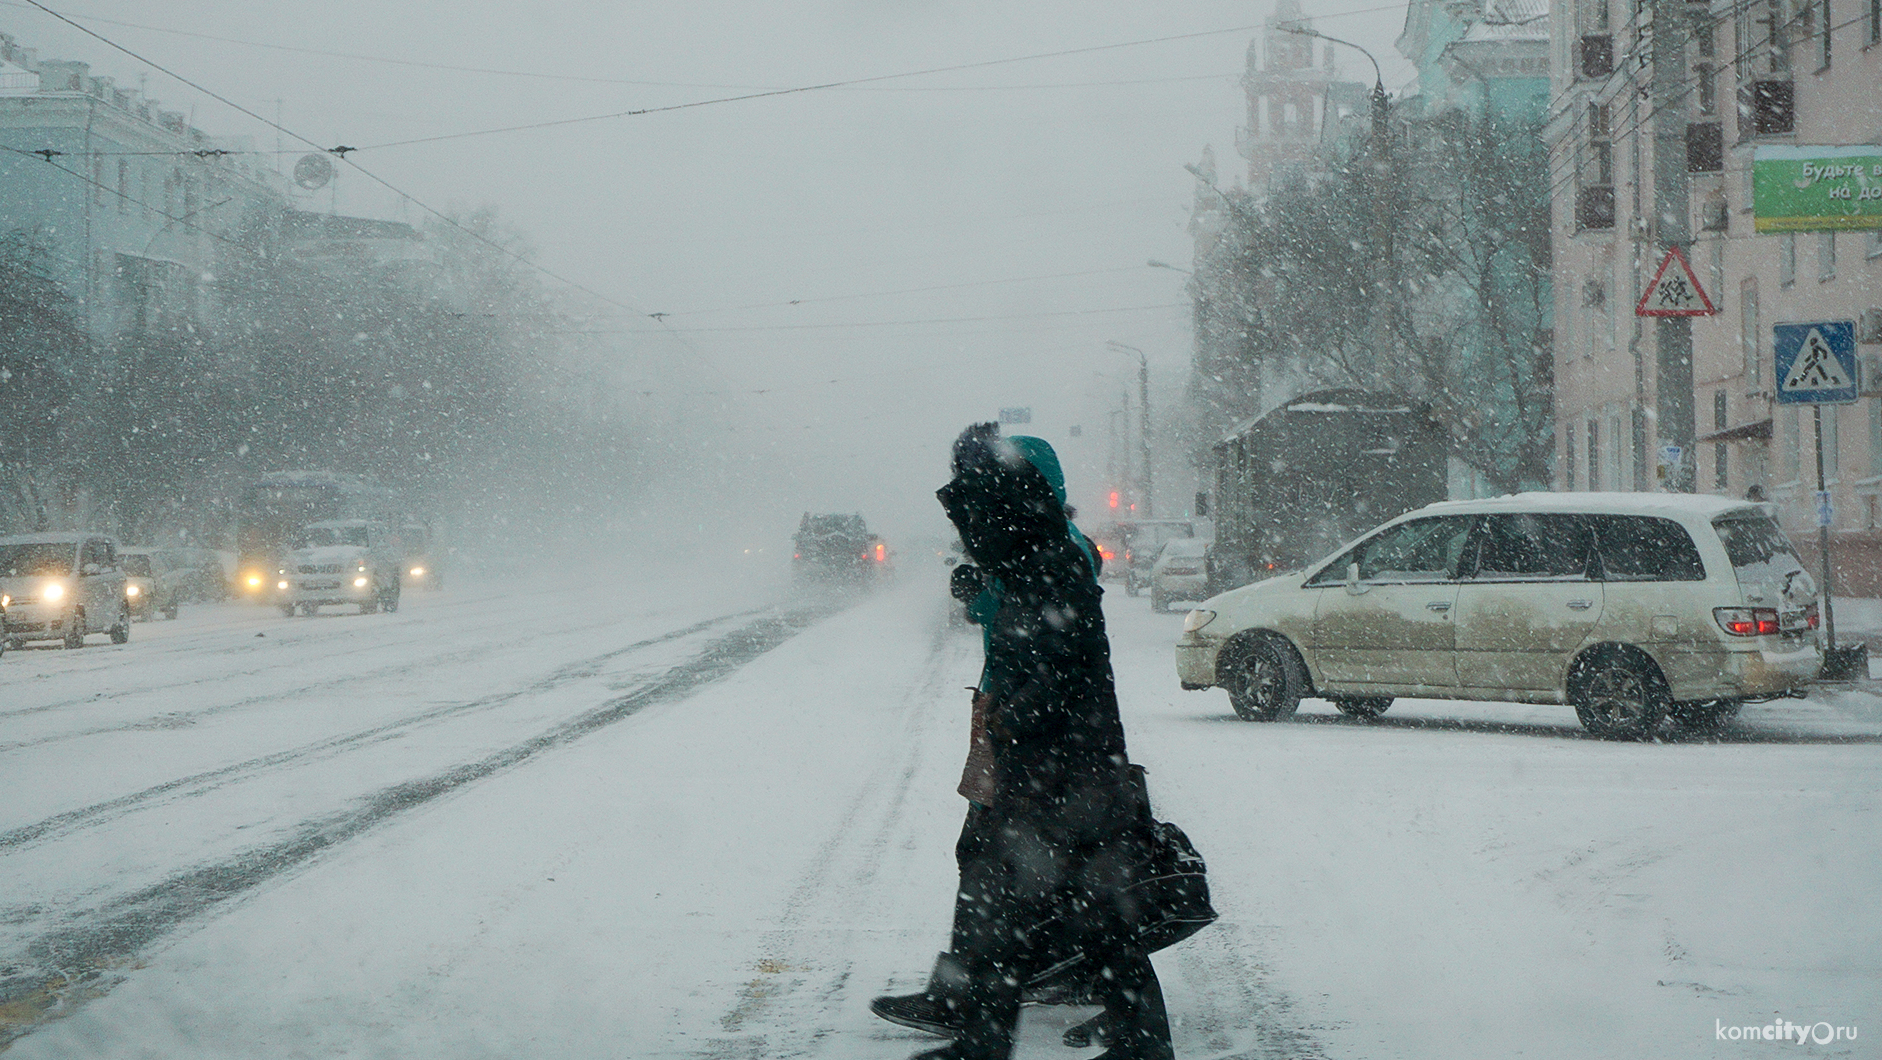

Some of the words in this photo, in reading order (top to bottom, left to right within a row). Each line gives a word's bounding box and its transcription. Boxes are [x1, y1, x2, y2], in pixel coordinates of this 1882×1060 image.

[1803, 162, 1864, 182] Будьте
[1829, 186, 1851, 199] на
[1858, 186, 1882, 201] до
